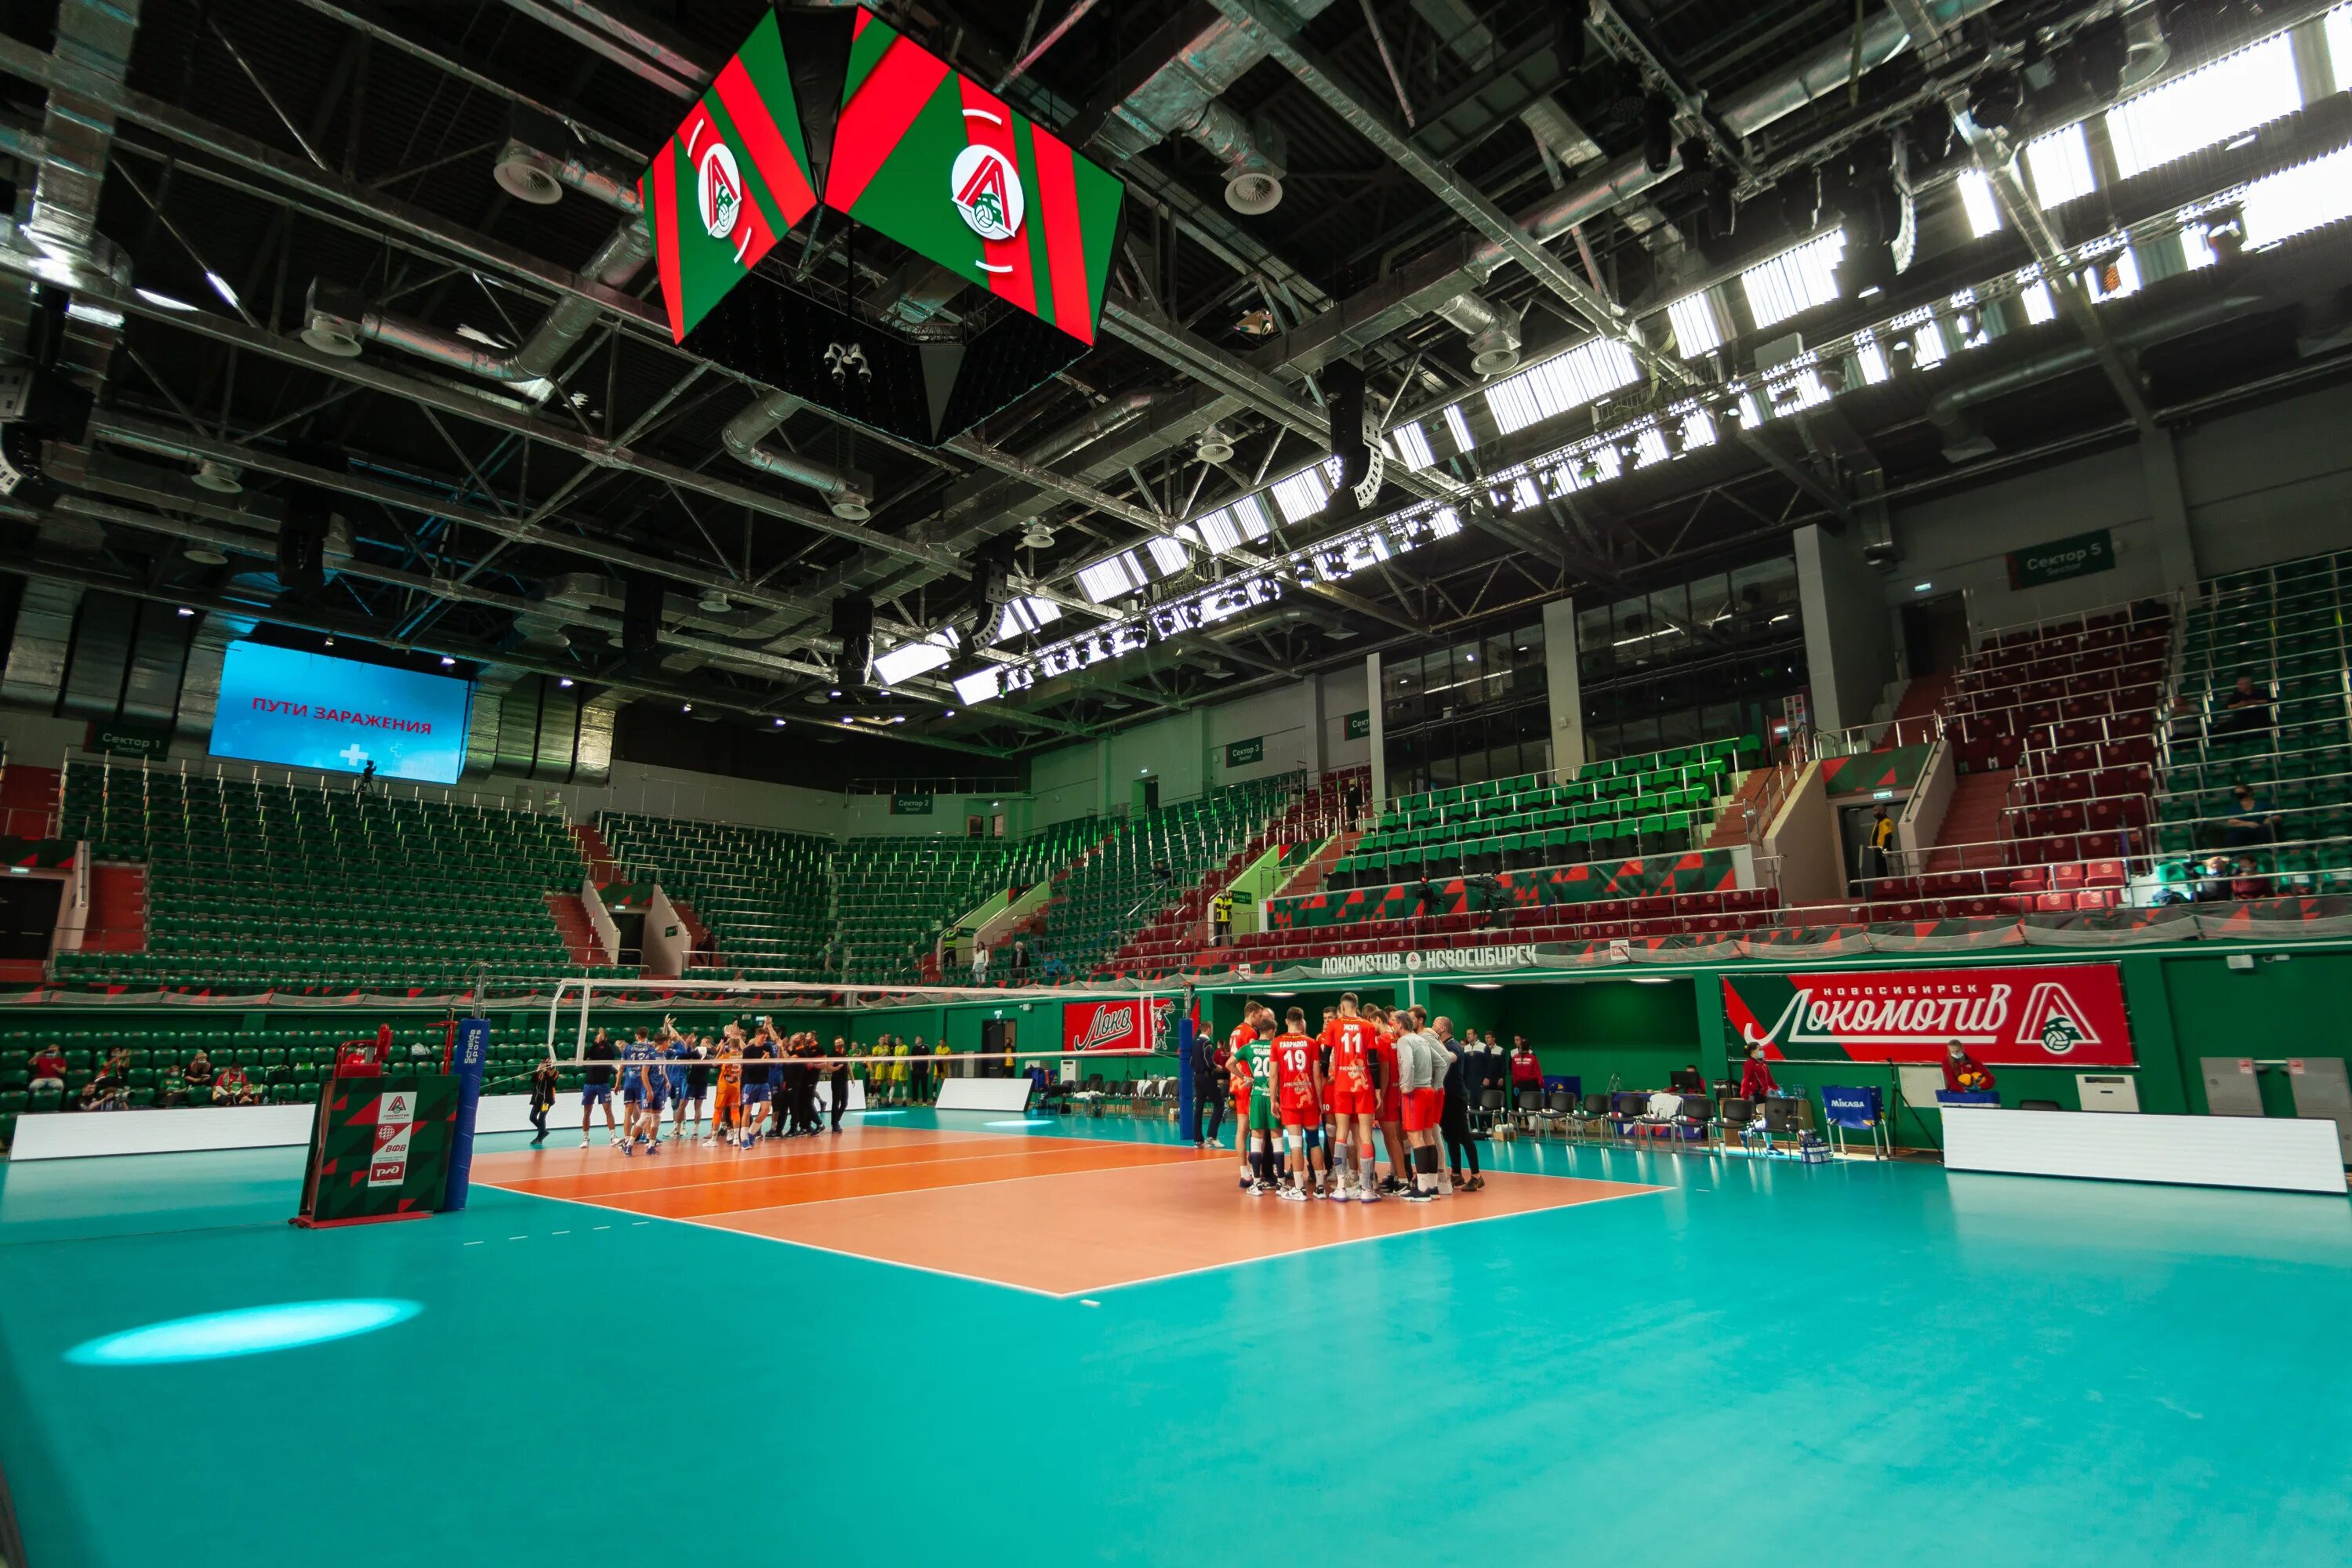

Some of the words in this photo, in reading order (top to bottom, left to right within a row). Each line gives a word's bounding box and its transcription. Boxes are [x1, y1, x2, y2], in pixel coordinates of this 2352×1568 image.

[2027, 549, 2087, 570] Сектор
[2090, 542, 2101, 556] 5
[252, 697, 308, 717] ПУТИ
[314, 706, 432, 735] ЗАРАЖЕНИЯ
[1352, 718, 1370, 728] Сект
[103, 732, 150, 749] Сектор
[154, 739, 162, 749] 1
[1232, 747, 1254, 757] Сектор
[1321, 953, 1401, 975] ЛОКОМОТИВ
[1426, 944, 1538, 970] НОВОСИБИРСК
[1823, 984, 1978, 996] НОВОСИБИРСК
[1074, 1004, 1133, 1051] Локо
[470, 1029, 481, 1064] Sports
[1279, 1040, 1308, 1048] ГАВРИЛОВ
[1341, 1033, 1361, 1054] 11
[1252, 1056, 1271, 1077] 20
[1283, 1049, 1307, 1071] 19
[385, 1144, 407, 1152] ВФВ
